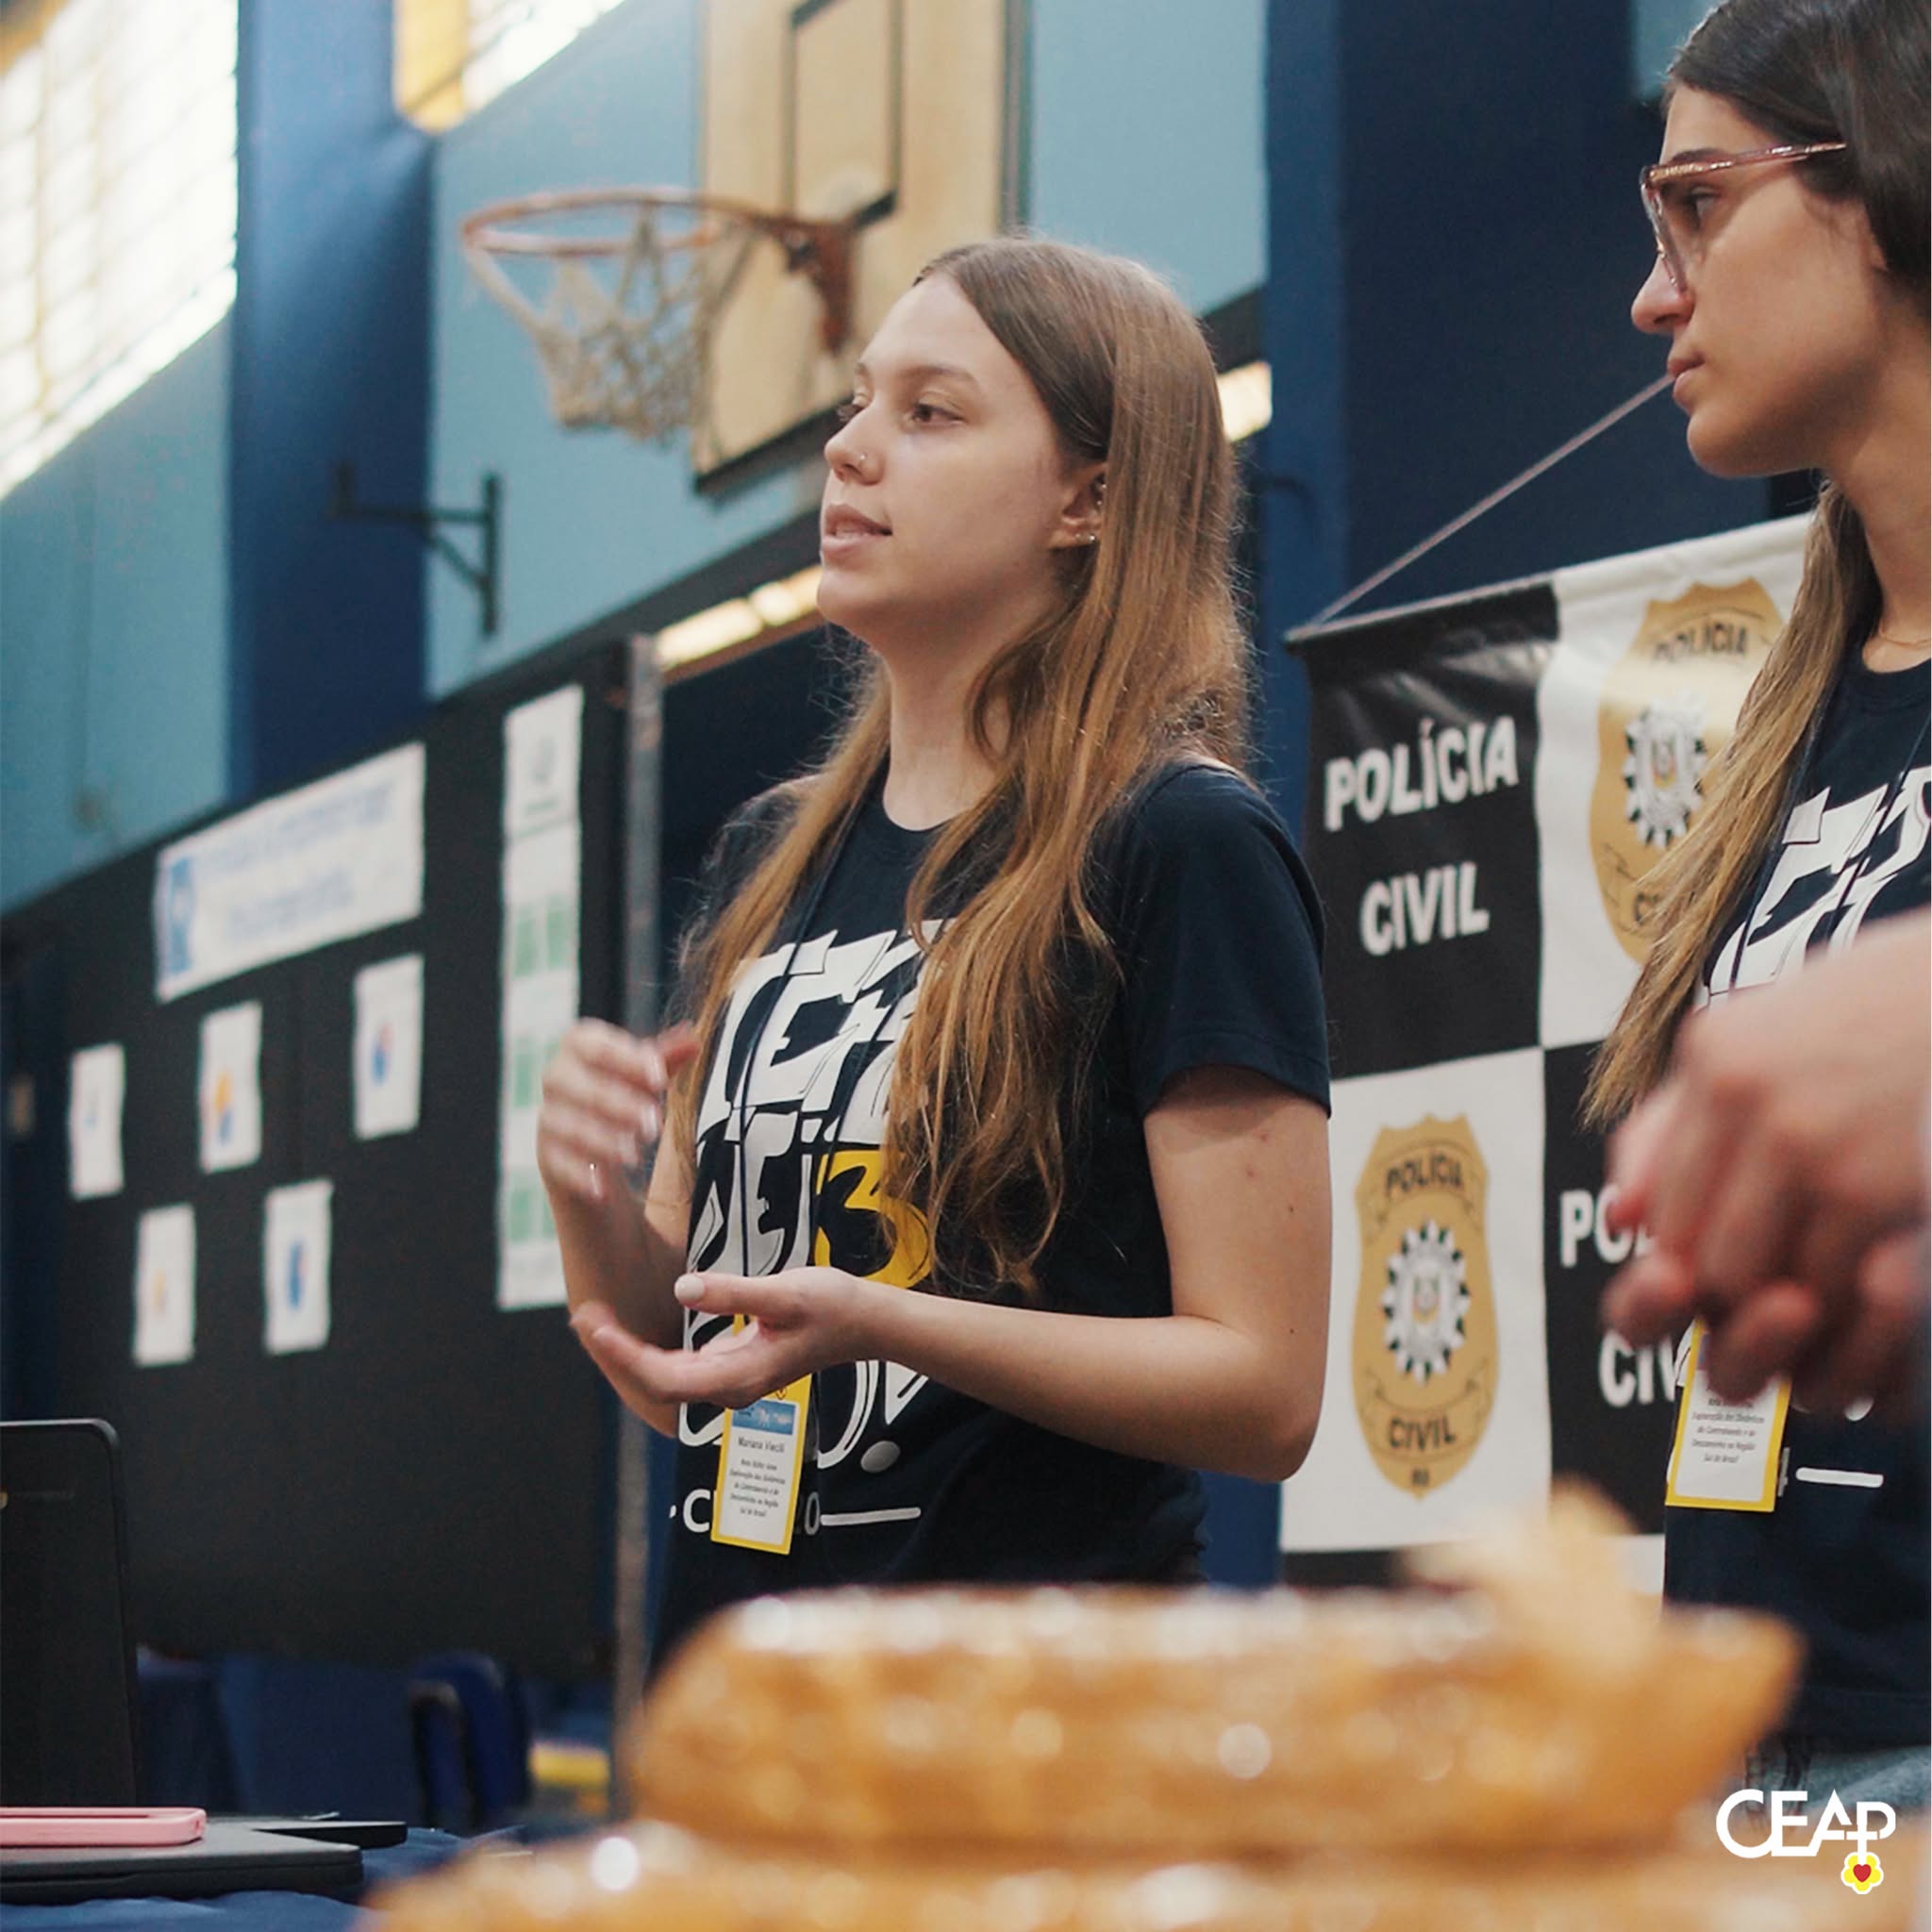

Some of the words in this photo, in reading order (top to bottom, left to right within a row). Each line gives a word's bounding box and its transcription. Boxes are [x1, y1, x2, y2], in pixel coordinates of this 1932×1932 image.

[1325, 717, 1519, 832] POLÍCIA
[1359, 860, 1490, 957] CIVIL
[1388, 1415, 1456, 1451] CIVIL
